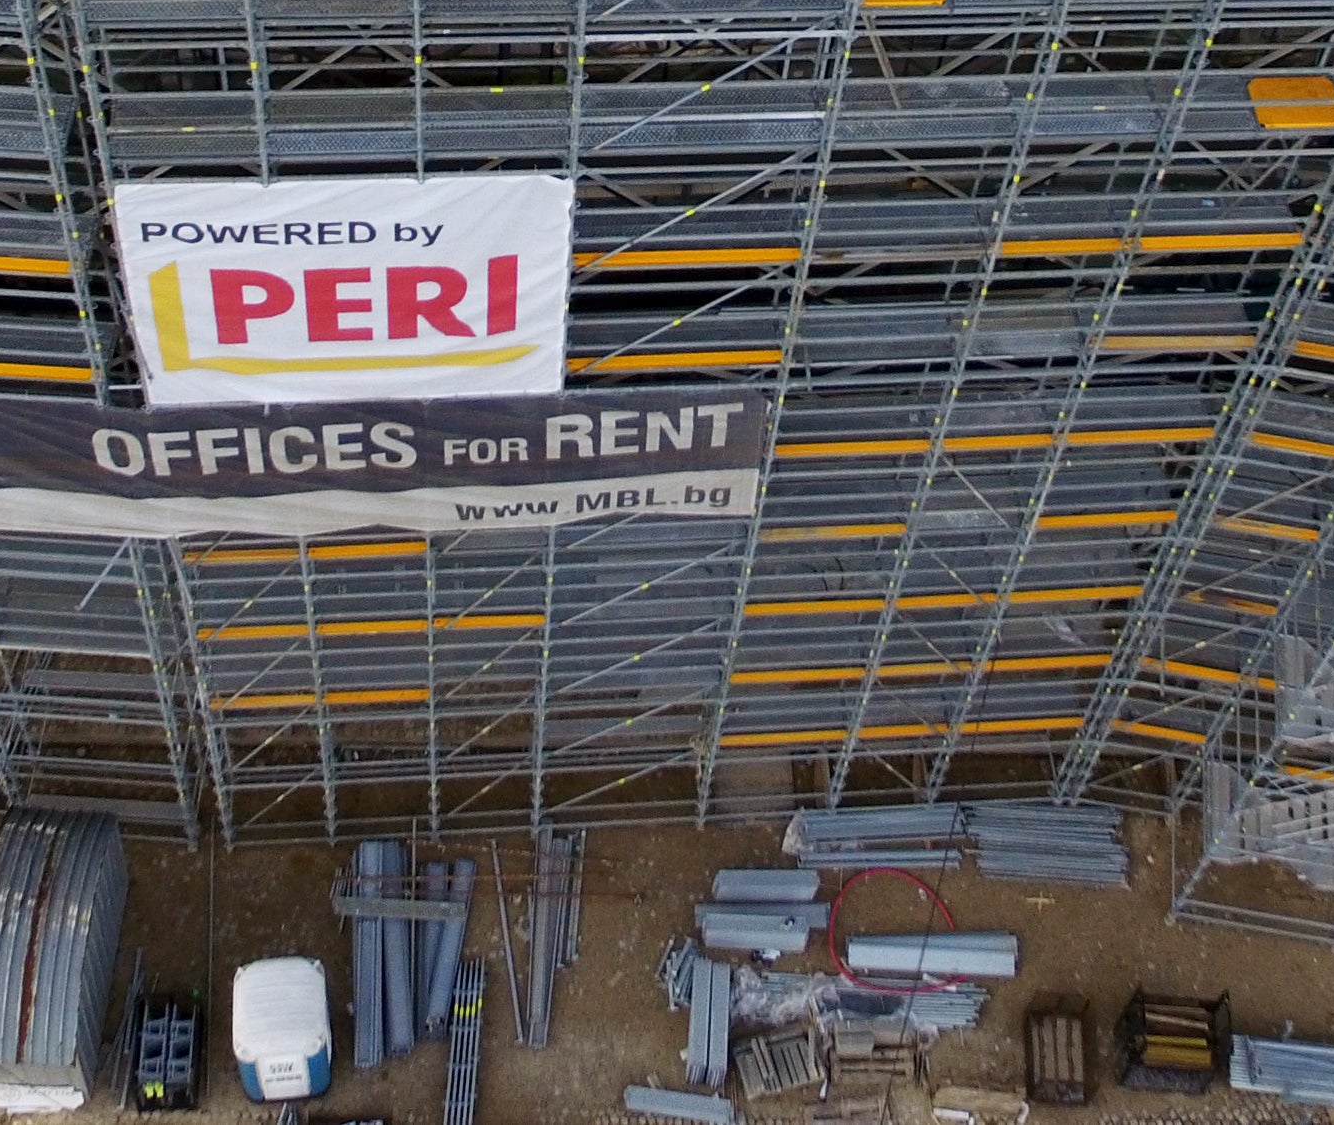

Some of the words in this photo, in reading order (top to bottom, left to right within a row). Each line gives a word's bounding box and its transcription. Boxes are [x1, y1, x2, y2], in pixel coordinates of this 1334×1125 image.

[140, 220, 377, 245] POWERED
[394, 222, 445, 247] by
[209, 254, 519, 345] PERI
[91, 421, 417, 477] OFFICES
[442, 436, 528, 466] FOR
[545, 402, 744, 459] RENT
